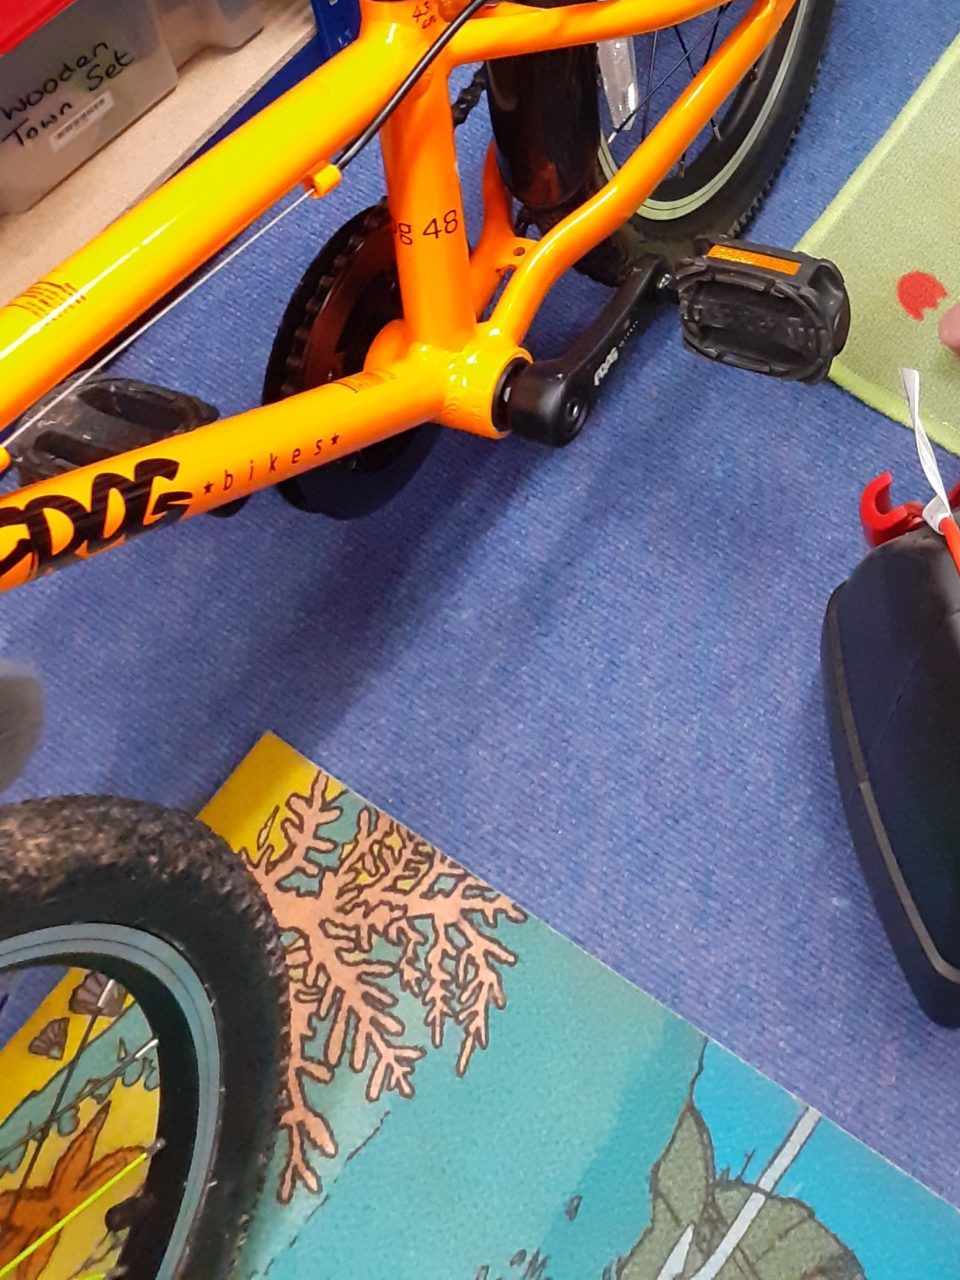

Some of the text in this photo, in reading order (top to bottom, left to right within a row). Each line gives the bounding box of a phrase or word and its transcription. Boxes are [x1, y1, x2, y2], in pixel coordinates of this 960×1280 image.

[0, 51, 135, 146] Town Set
[422, 209, 458, 240] 48
[222, 437, 323, 492] bikes
